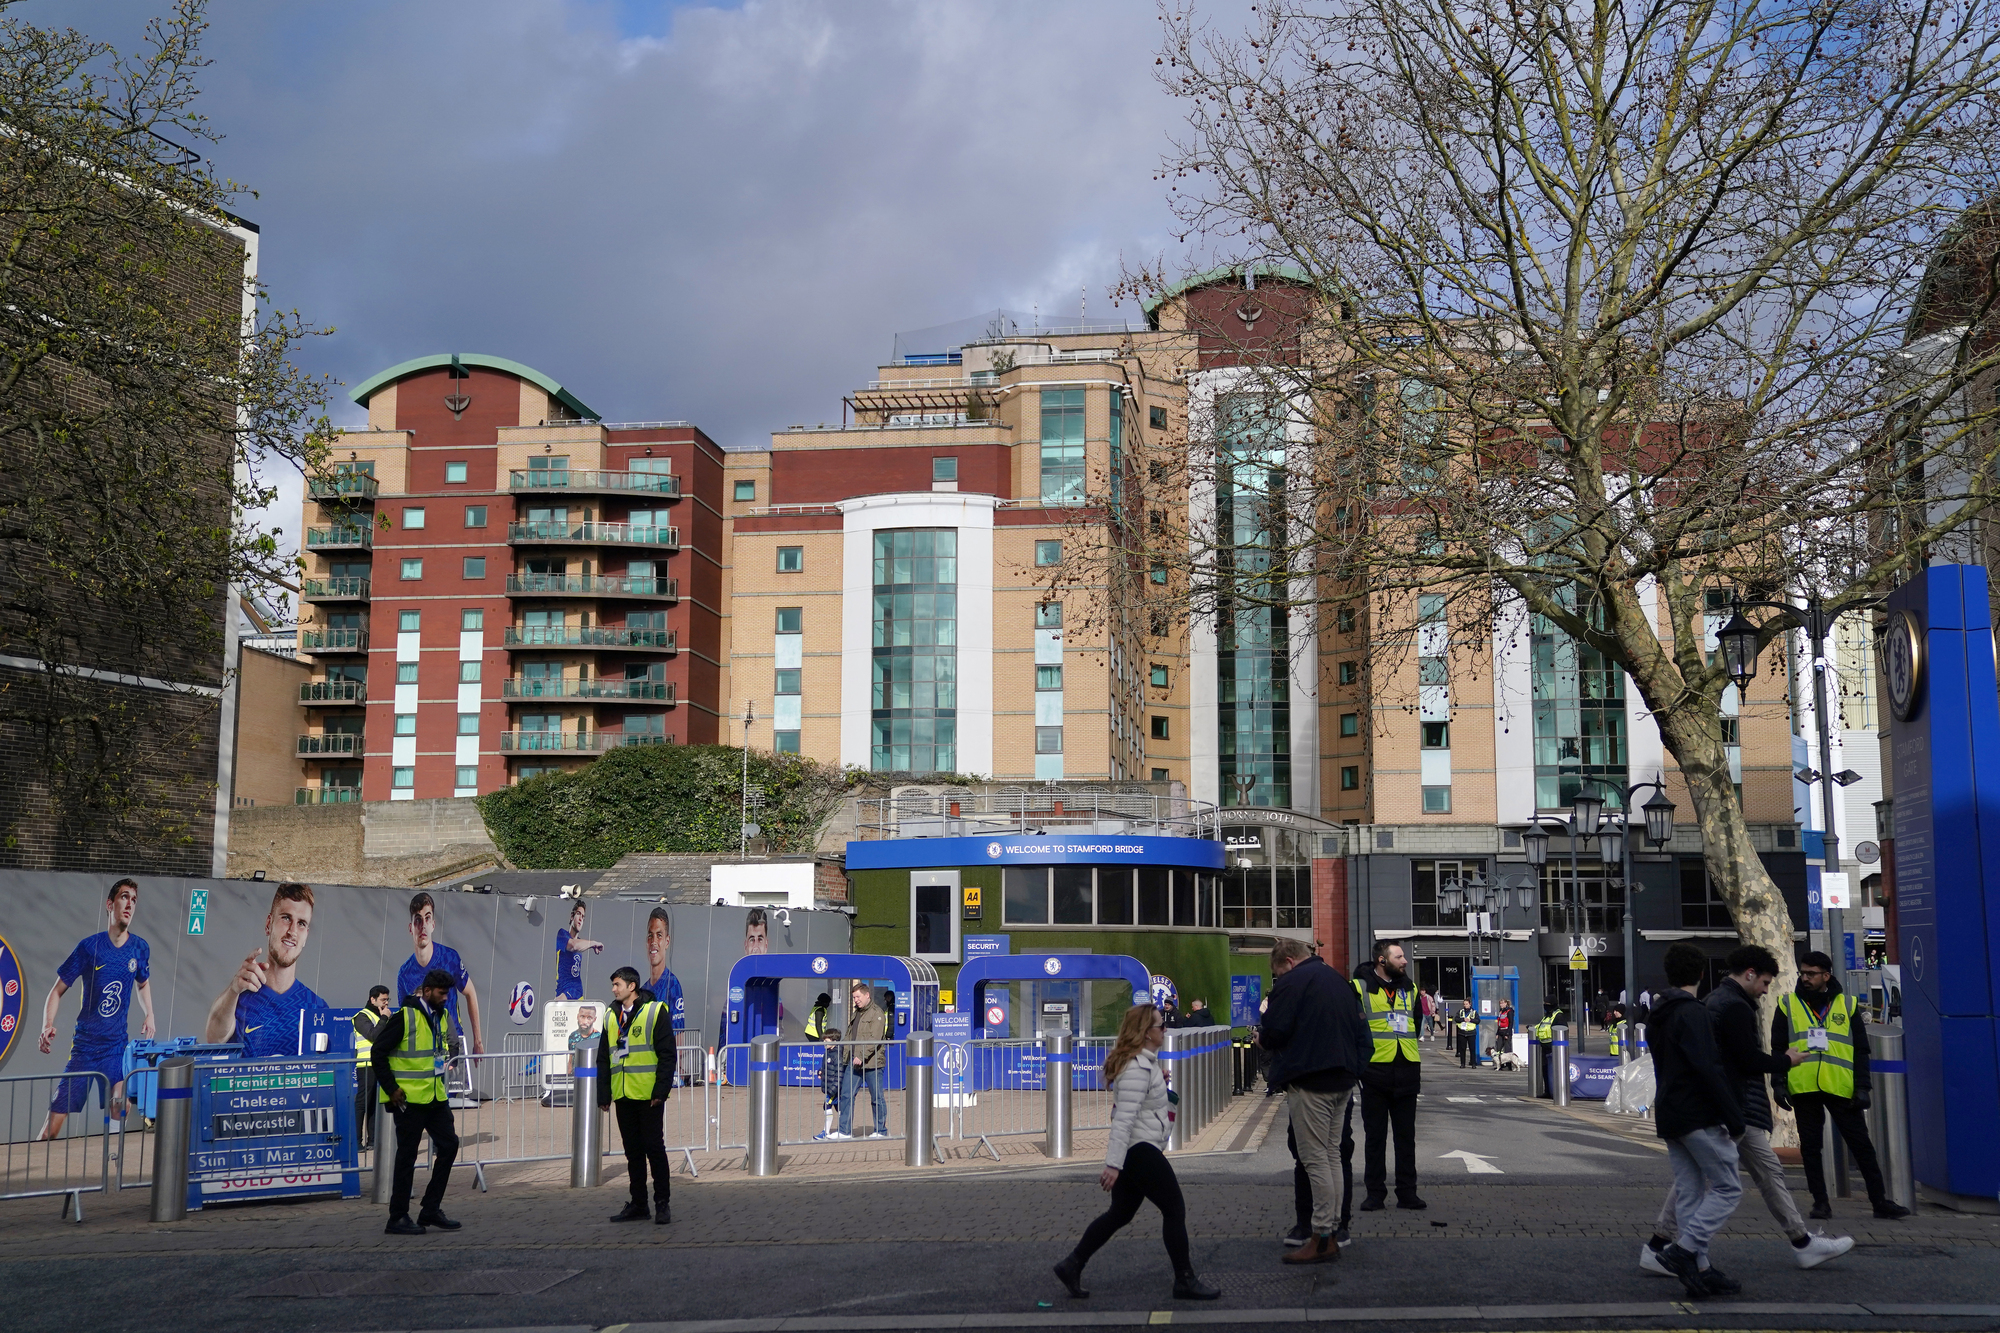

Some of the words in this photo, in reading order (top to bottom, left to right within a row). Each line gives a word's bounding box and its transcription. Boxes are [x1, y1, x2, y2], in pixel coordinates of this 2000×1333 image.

[1896, 736, 1924, 760] STAMFORD
[1903, 760, 1918, 777] GATE
[1192, 810, 1257, 824] COPHORNE
[1262, 811, 1295, 825] HOTEL
[1005, 845, 1051, 854] WELCOME
[1052, 844, 1065, 853] TO
[1067, 844, 1113, 853] STAMFORD
[1115, 845, 1144, 854] BRIDGE
[966, 892, 979, 902] AA
[191, 917, 201, 932] A
[1569, 936, 1607, 953] 105
[934, 1016, 969, 1024] WELCOME
[229, 1076, 275, 1089] Premier
[278, 1074, 318, 1088] League
[230, 1095, 287, 1108] Chelsea
[301, 1093, 315, 1104] V.
[222, 1116, 296, 1132] Newcastle
[199, 1154, 226, 1168] Sun
[241, 1153, 255, 1165] 13
[266, 1150, 296, 1163] Mar
[305, 1148, 333, 1160] 2.00
[221, 1172, 273, 1189] SOLD
[283, 1168, 324, 1184] OUT
